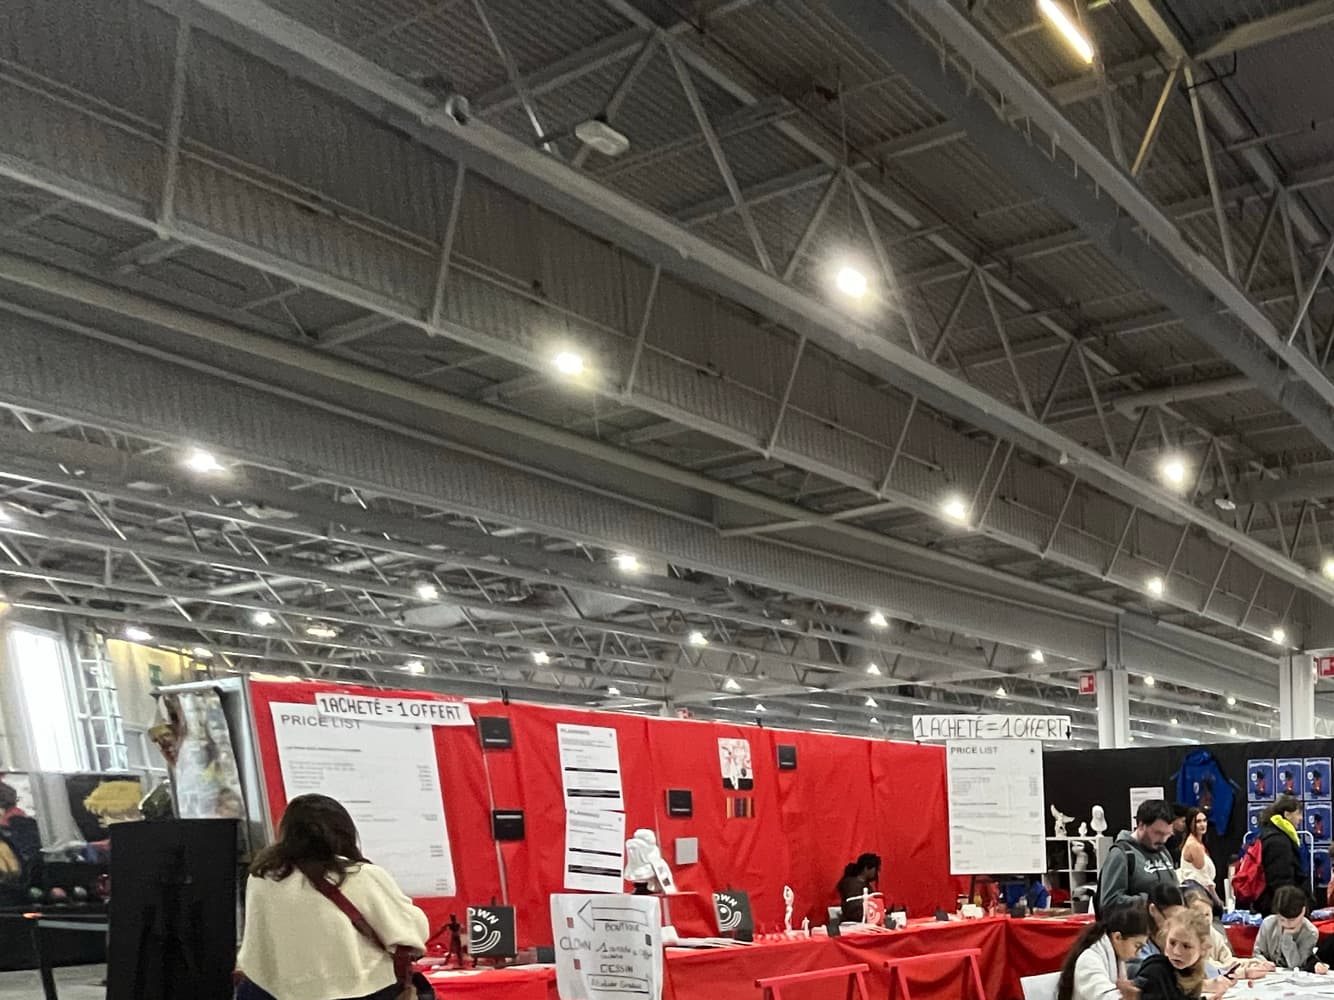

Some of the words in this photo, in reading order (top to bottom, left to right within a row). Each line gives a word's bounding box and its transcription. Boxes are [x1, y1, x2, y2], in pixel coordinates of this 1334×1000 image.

[281, 714, 328, 727] PRICE
[332, 716, 361, 729] LIST
[950, 746, 977, 754] PRICE
[980, 746, 998, 754] LIST
